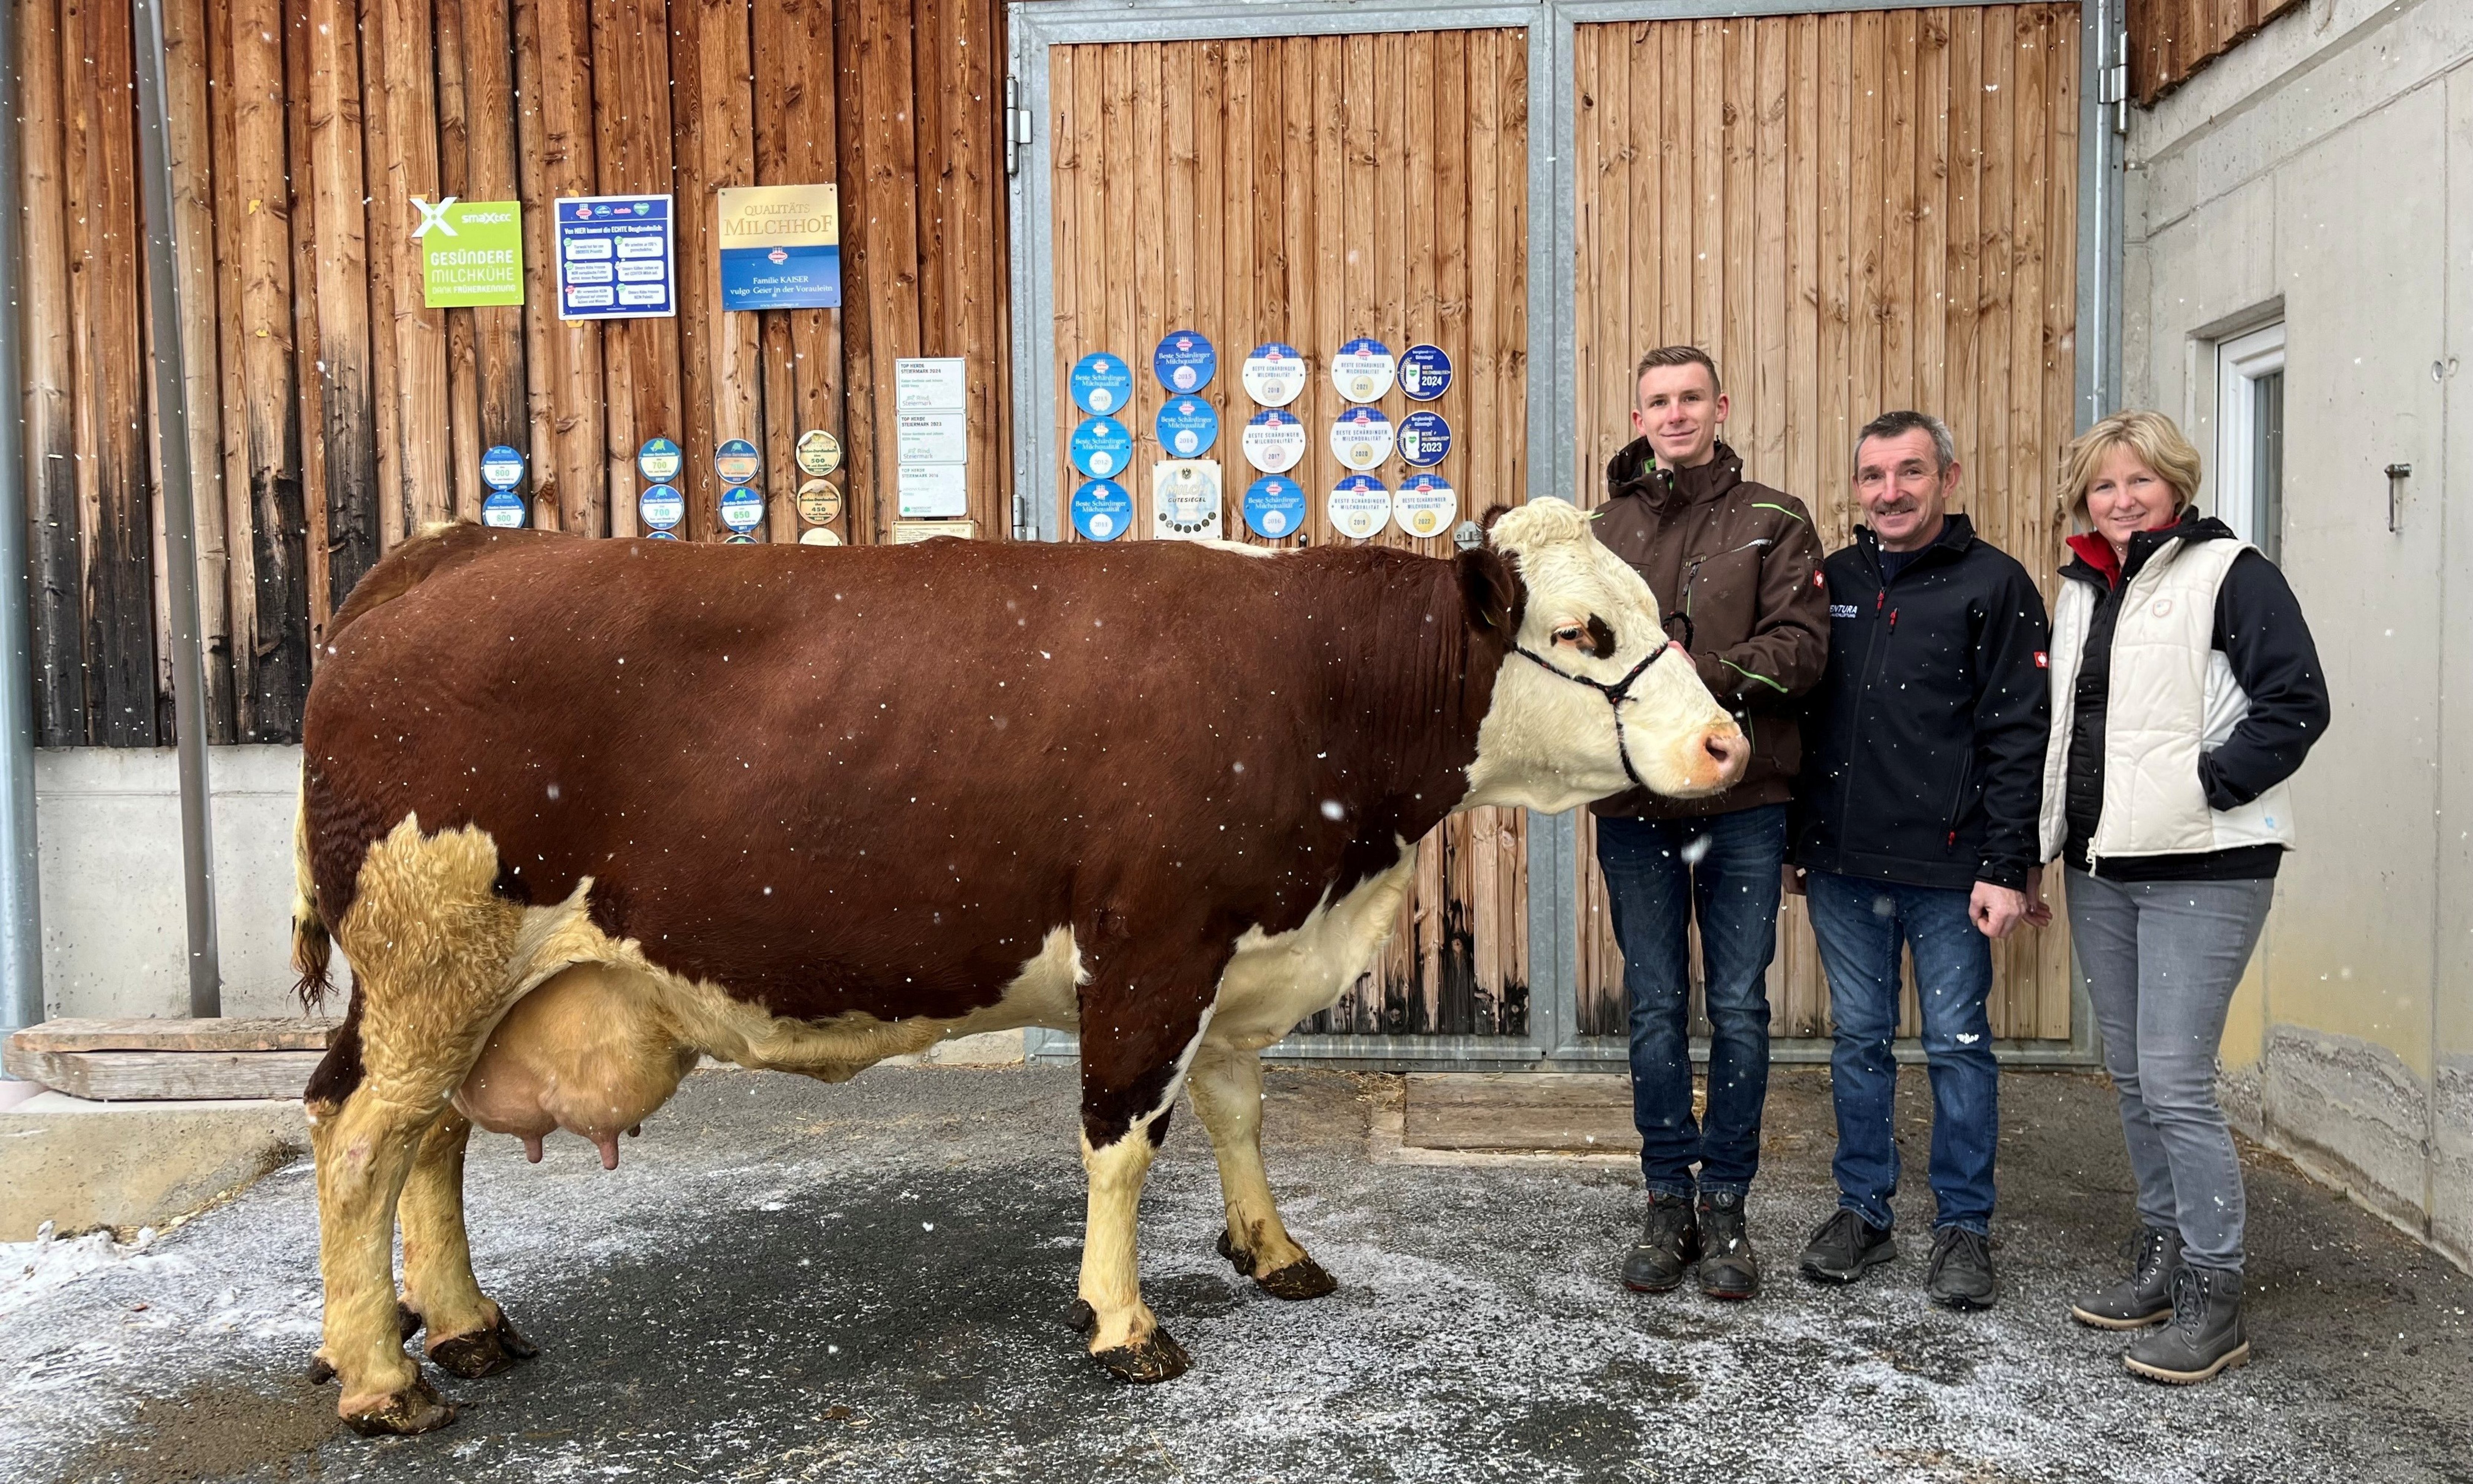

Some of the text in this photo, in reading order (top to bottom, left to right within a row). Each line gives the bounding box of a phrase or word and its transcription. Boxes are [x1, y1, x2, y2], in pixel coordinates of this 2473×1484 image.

[745, 202, 810, 216] QUALITÄTS
[430, 249, 513, 266] GESÜNDERE
[431, 266, 513, 283] MILCHKÜHE
[453, 285, 516, 293] FRÜHERKENNUNG
[730, 288, 750, 296] vulgo
[1422, 376, 1442, 386] 2024
[1421, 443, 1442, 452] 2023
